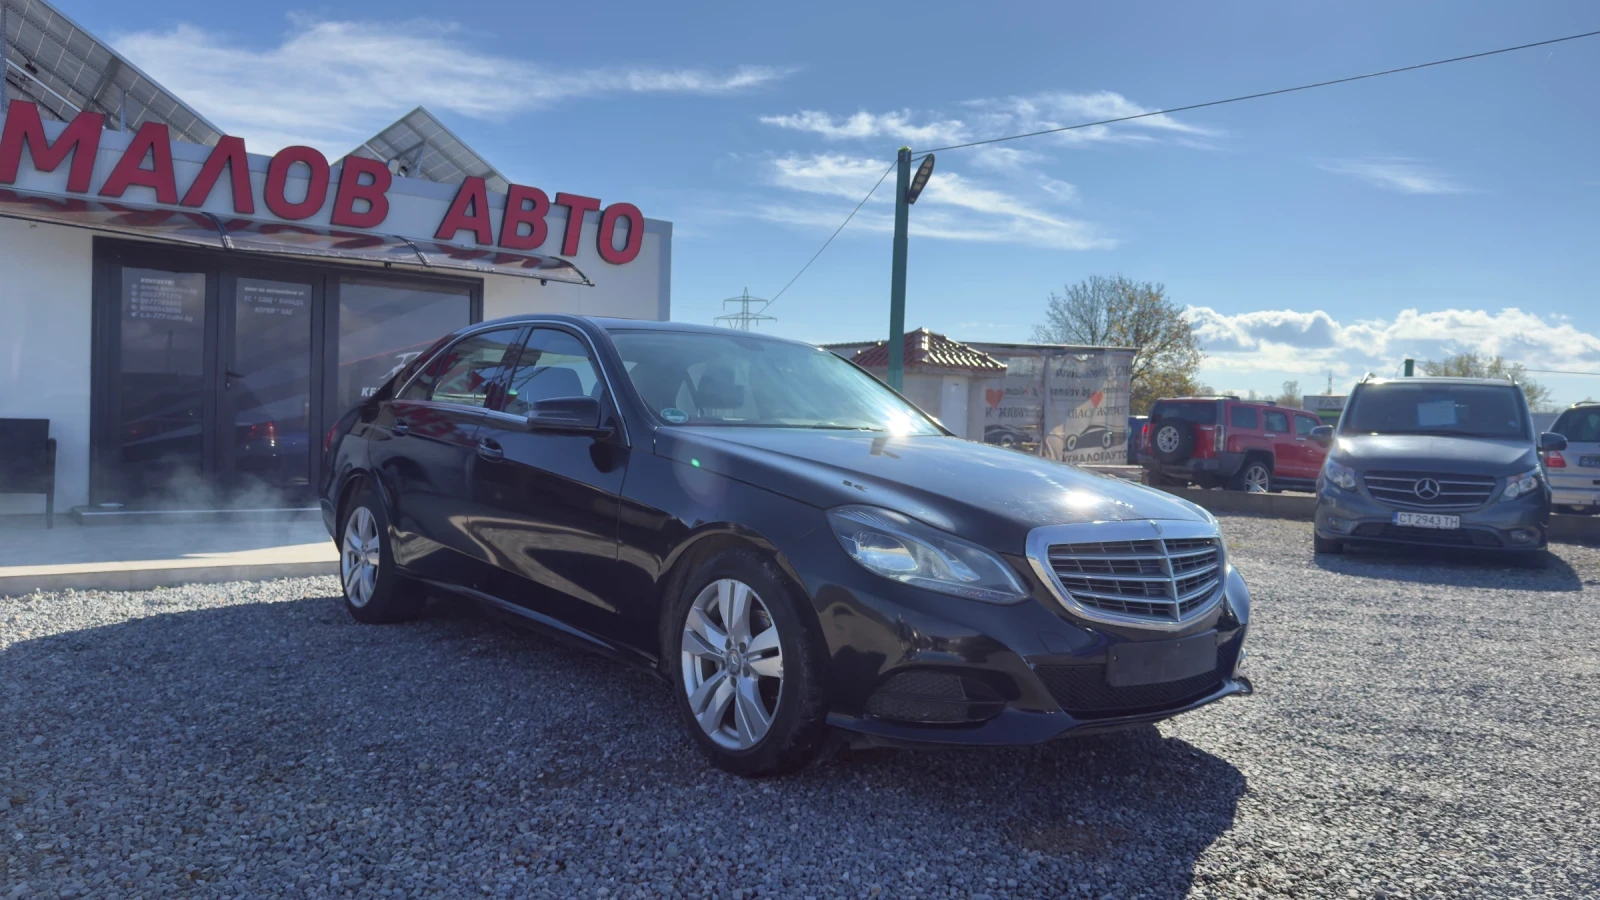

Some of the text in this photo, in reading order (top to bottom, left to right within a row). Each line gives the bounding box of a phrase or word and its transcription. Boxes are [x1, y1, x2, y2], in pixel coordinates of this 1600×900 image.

[0, 99, 644, 264] МАЛОВ АВТО
[361, 387, 380, 397] КЕ
[1400, 513, 1458, 527] CT 2943 TH
